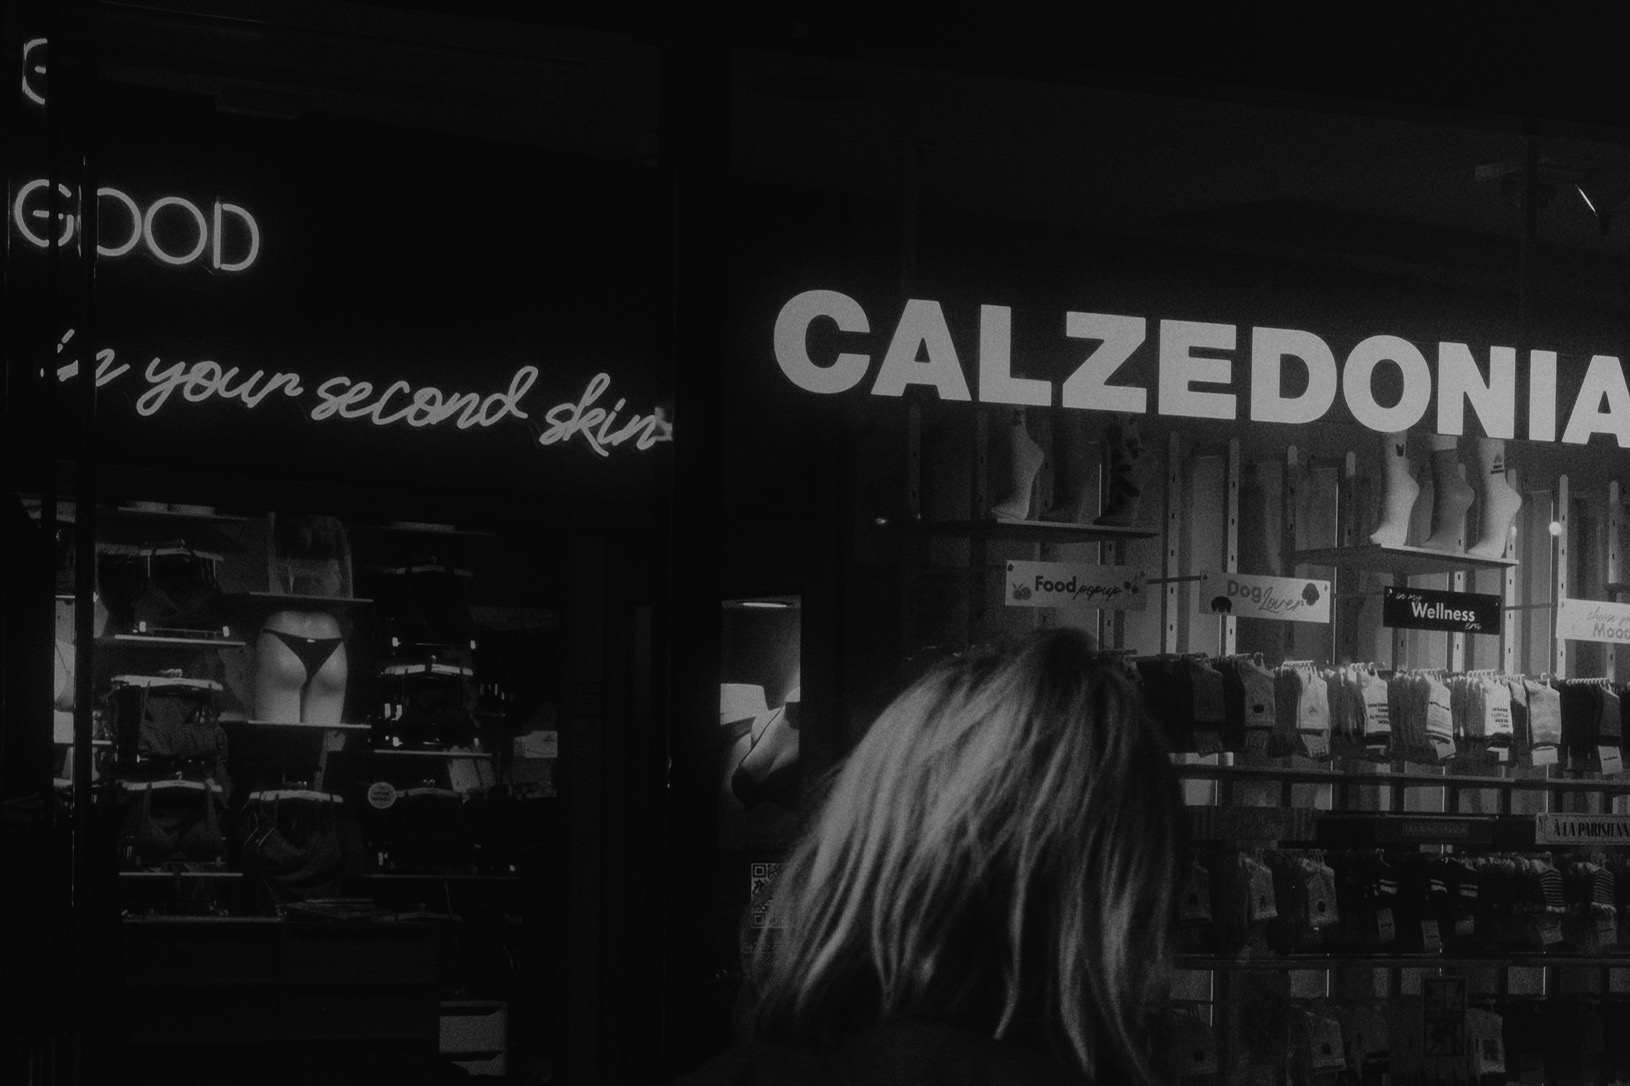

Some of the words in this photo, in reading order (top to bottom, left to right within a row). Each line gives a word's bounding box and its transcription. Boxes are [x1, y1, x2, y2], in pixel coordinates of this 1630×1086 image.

[13, 178, 261, 272] GOOD
[136, 355, 304, 418] your
[309, 364, 540, 430] second
[538, 372, 668, 457] skin
[1034, 574, 1077, 594] Food
[1226, 579, 1262, 603] Dog
[1407, 593, 1424, 607] my
[1411, 601, 1476, 622] Wellness
